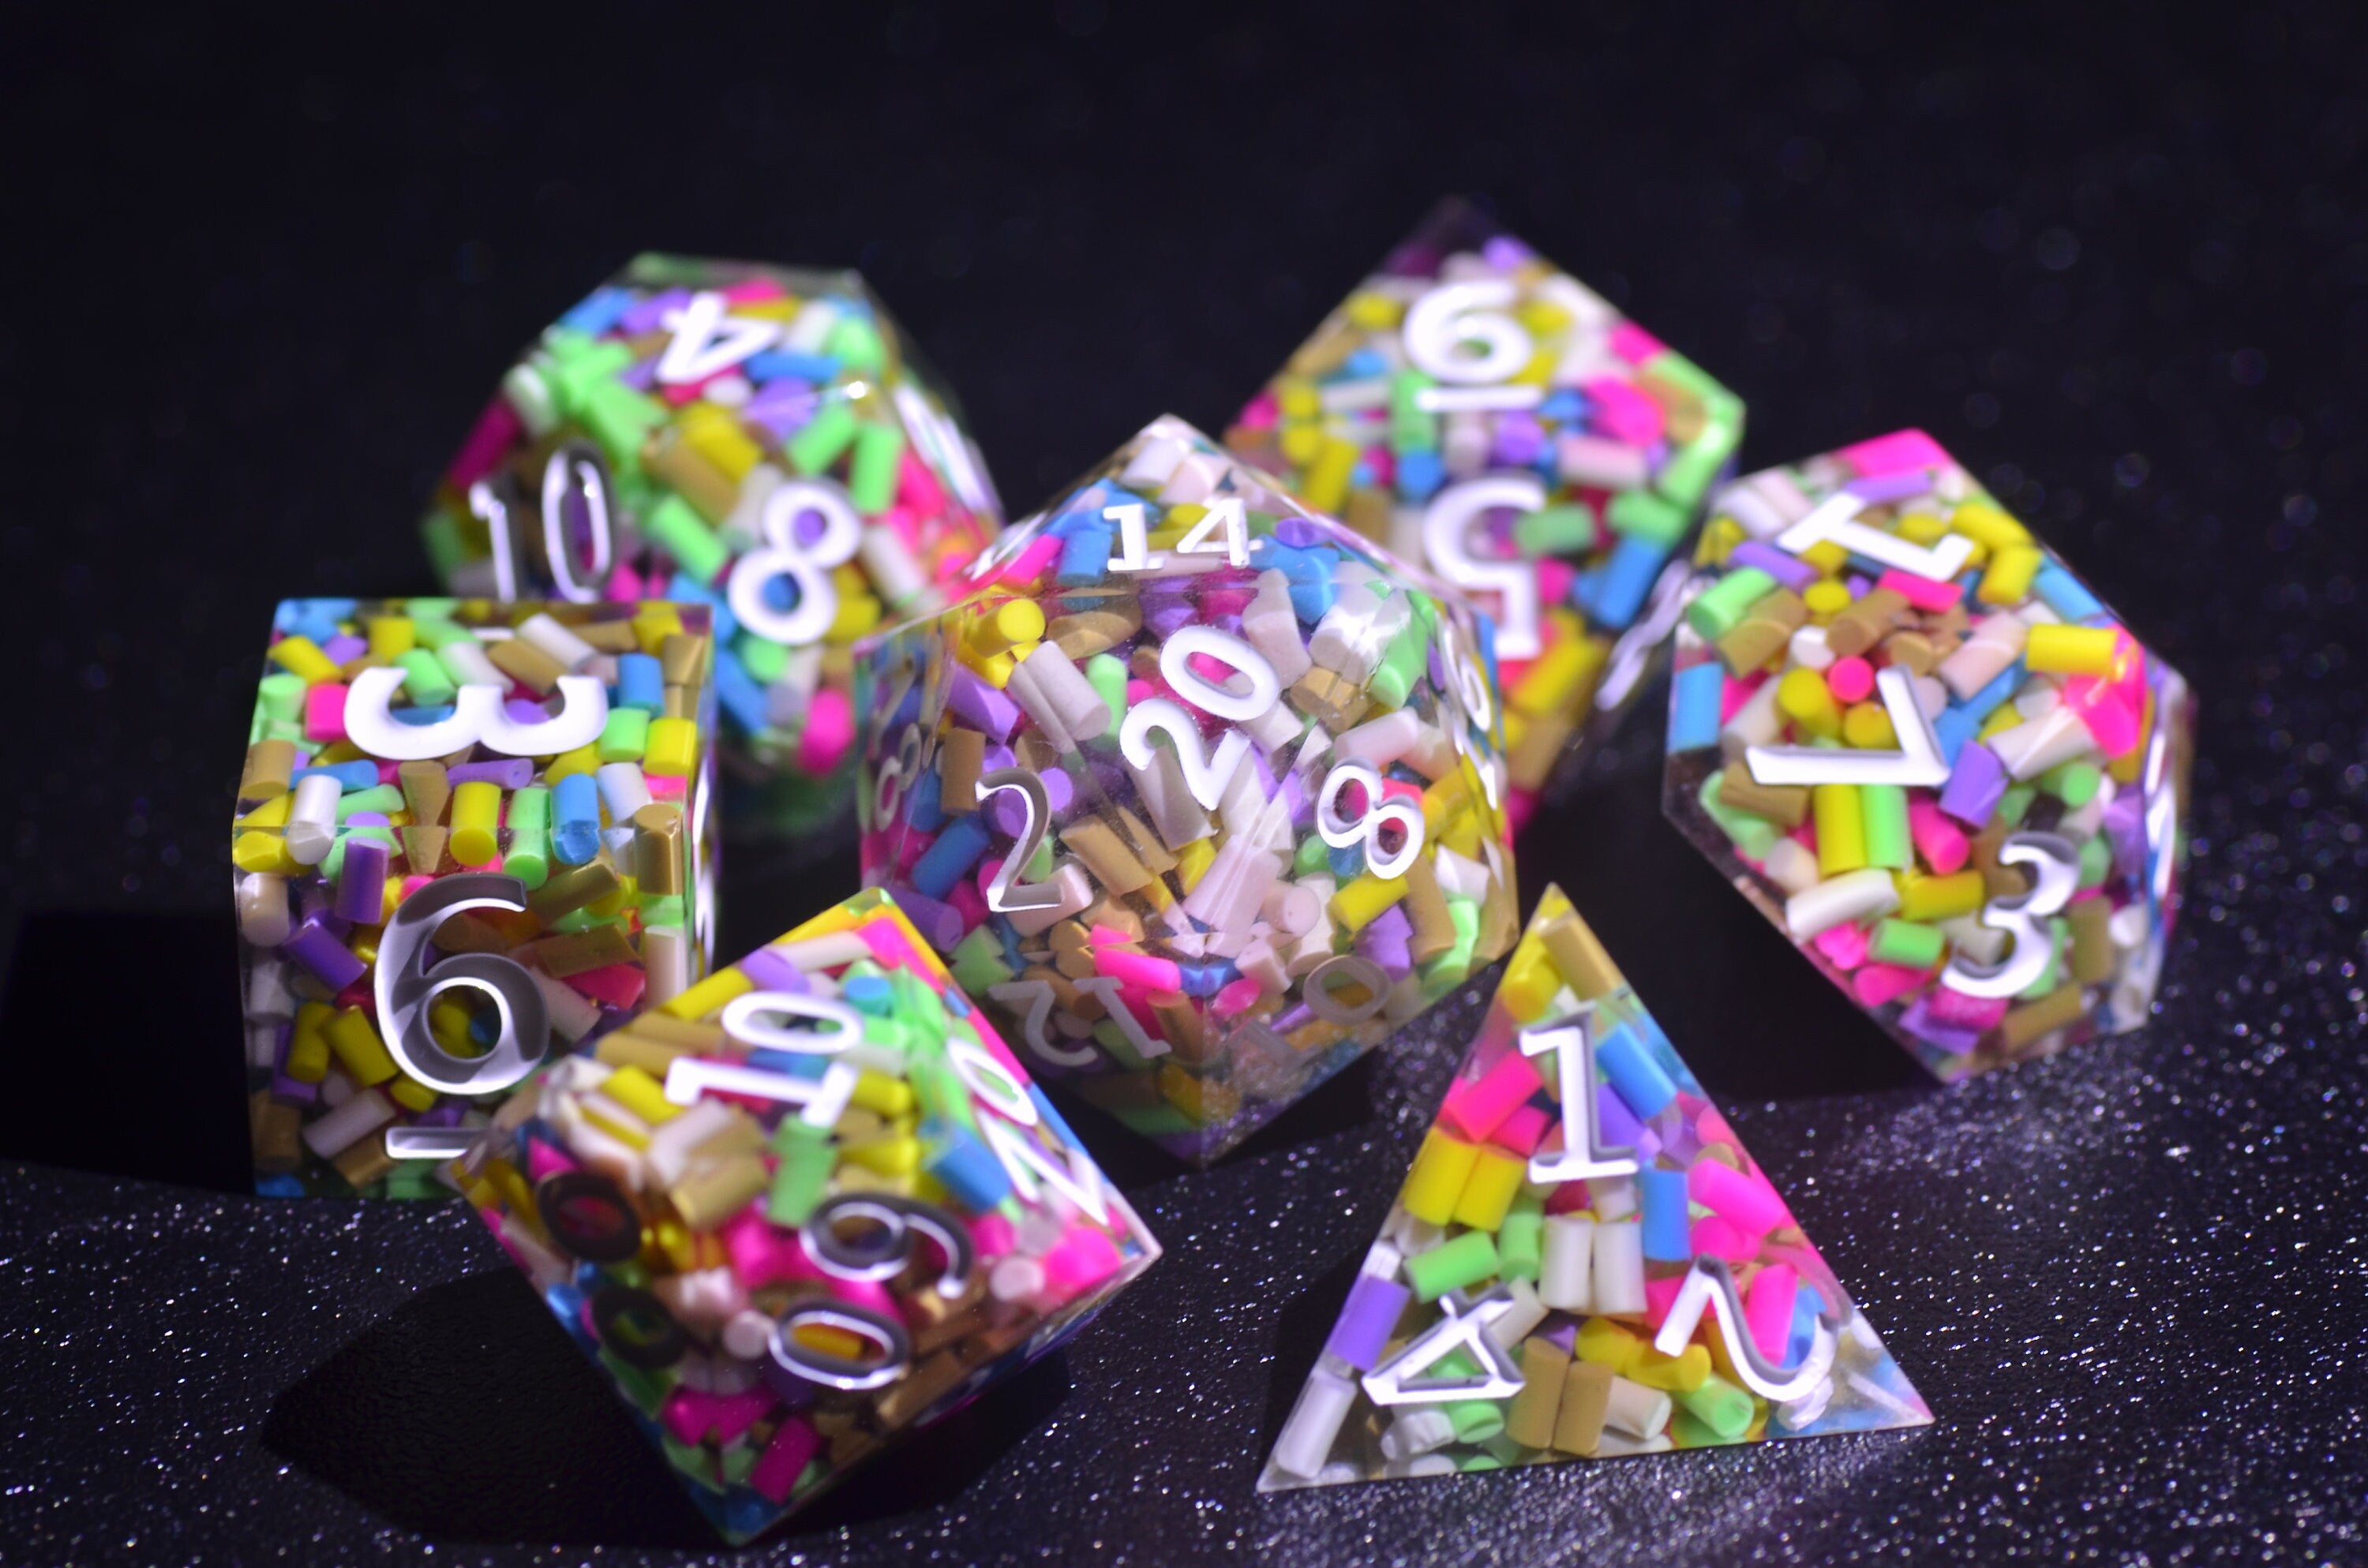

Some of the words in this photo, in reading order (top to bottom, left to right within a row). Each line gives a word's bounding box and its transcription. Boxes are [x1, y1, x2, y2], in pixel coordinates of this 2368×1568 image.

[655, 293, 782, 384] 4
[469, 443, 613, 604] 10
[728, 481, 862, 646] 8
[1103, 497, 1264, 573] 14
[1423, 473, 1547, 661] 5
[1775, 491, 1973, 582] 1
[343, 667, 609, 760] 3
[1118, 626, 1282, 811] 20
[1745, 664, 1952, 786] 7
[975, 766, 1068, 913] 2
[1317, 757, 1425, 879] 8
[1940, 830, 2081, 999] 3
[665, 990, 863, 1127] 10
[987, 976, 1173, 1067] 12
[1520, 1006, 1639, 1184] 1
[1362, 1289, 1526, 1405] 4
[1654, 1252, 1839, 1402] 2
